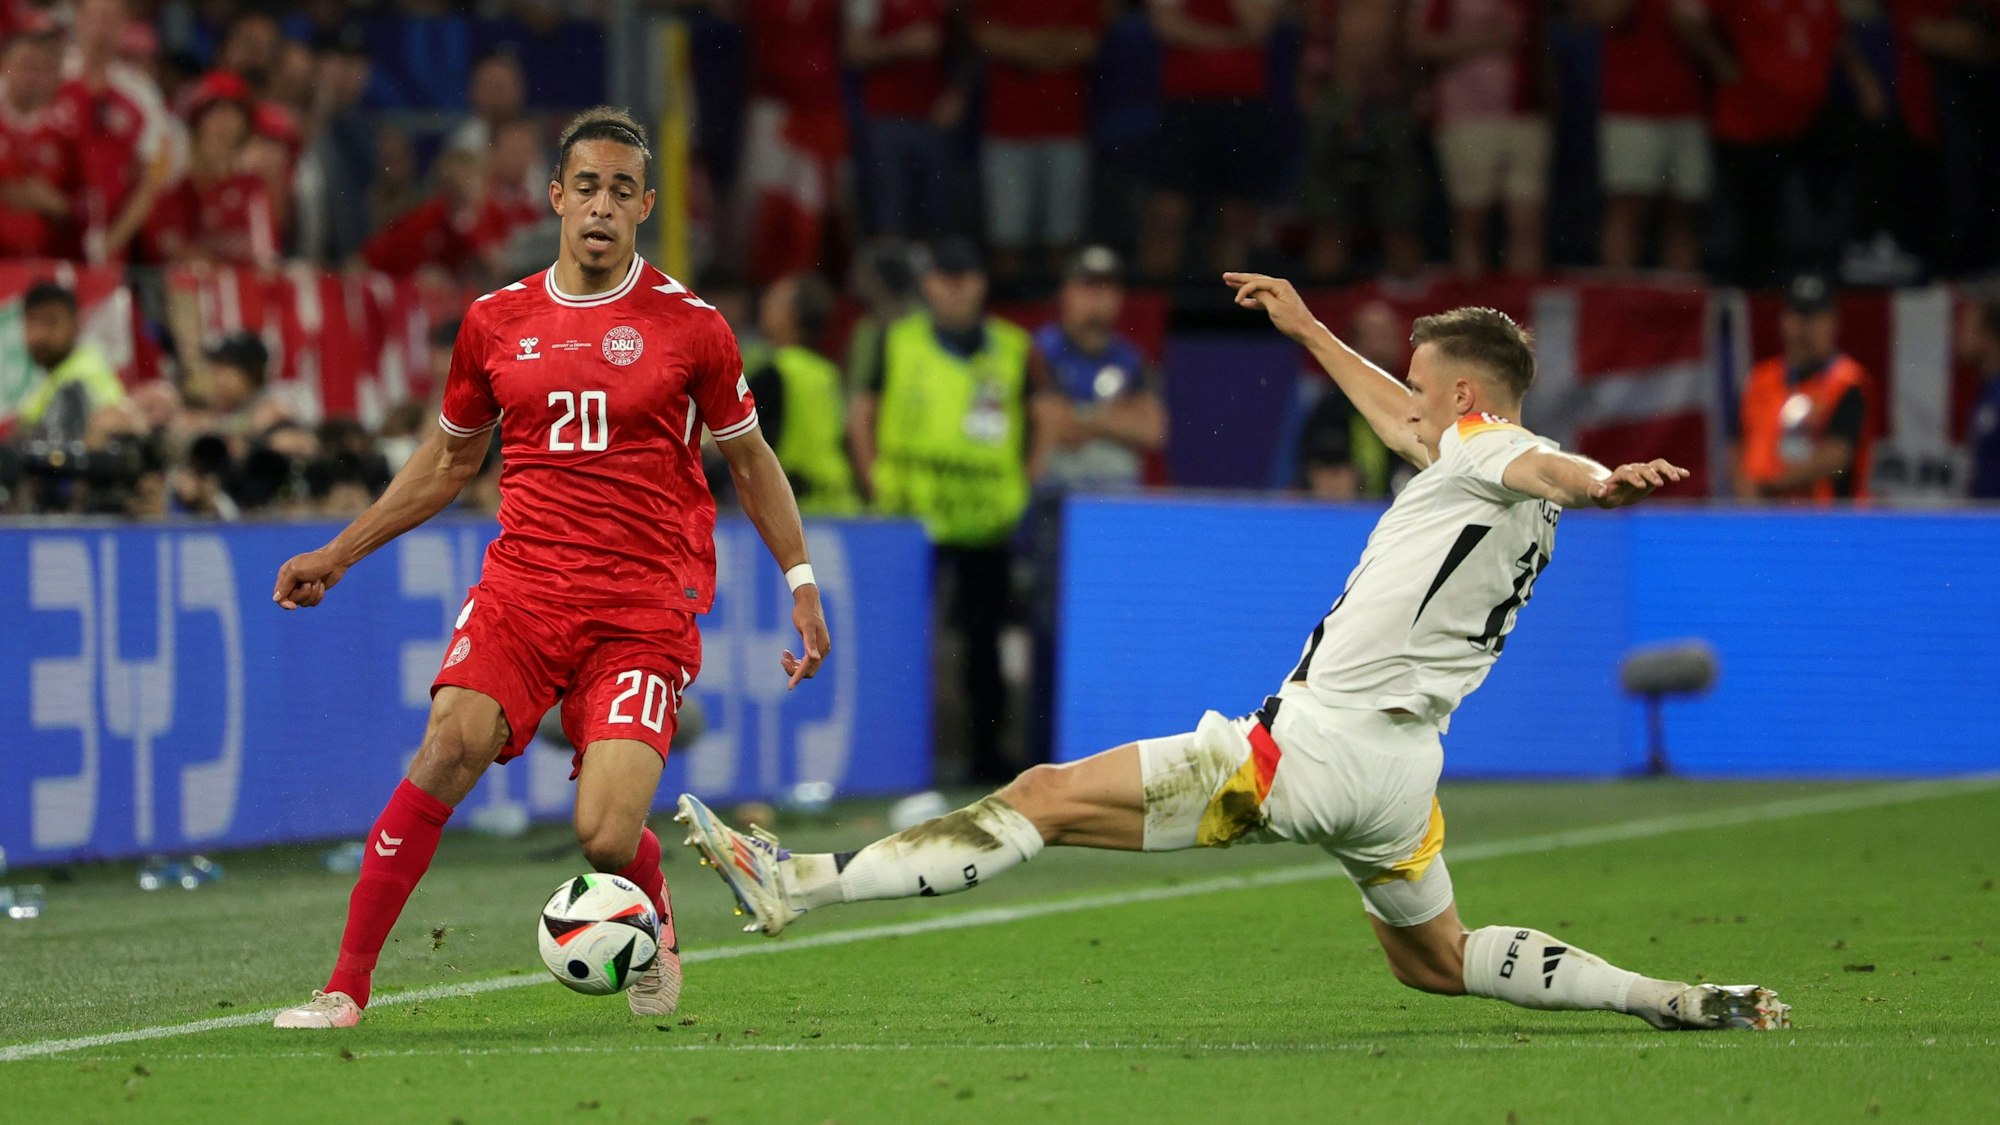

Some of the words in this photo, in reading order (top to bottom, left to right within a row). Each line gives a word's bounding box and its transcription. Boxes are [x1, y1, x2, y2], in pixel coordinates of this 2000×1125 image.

[516, 351, 541, 361] hummel
[611, 339, 635, 351] DBU
[548, 390, 608, 452] 20
[608, 669, 668, 734] 20
[1500, 930, 1530, 979] DFB
